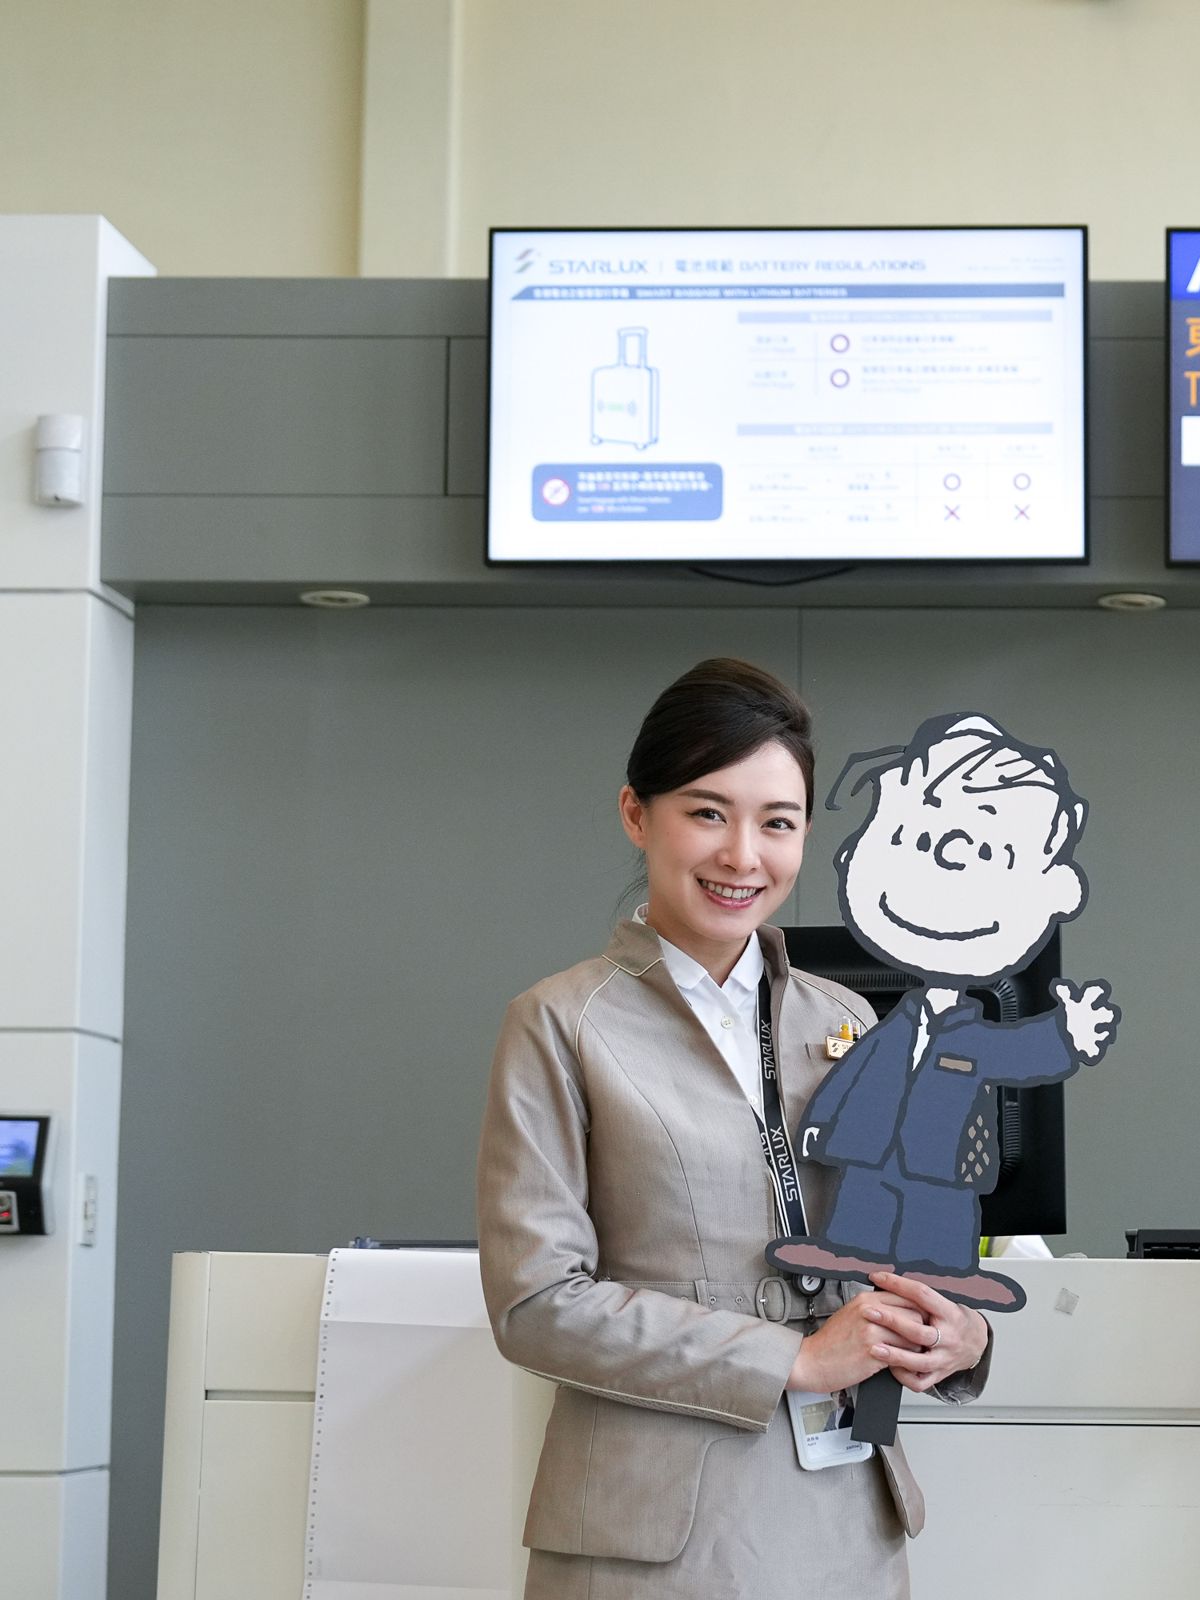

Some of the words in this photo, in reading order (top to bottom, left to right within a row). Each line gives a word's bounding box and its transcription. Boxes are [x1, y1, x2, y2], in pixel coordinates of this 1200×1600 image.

[549, 260, 648, 274] STARLUX
[739, 259, 810, 273] BATTERY
[814, 258, 928, 272] REGULATIONS
[760, 1019, 777, 1081] STARLUX
[770, 1125, 799, 1202] STARLUX
